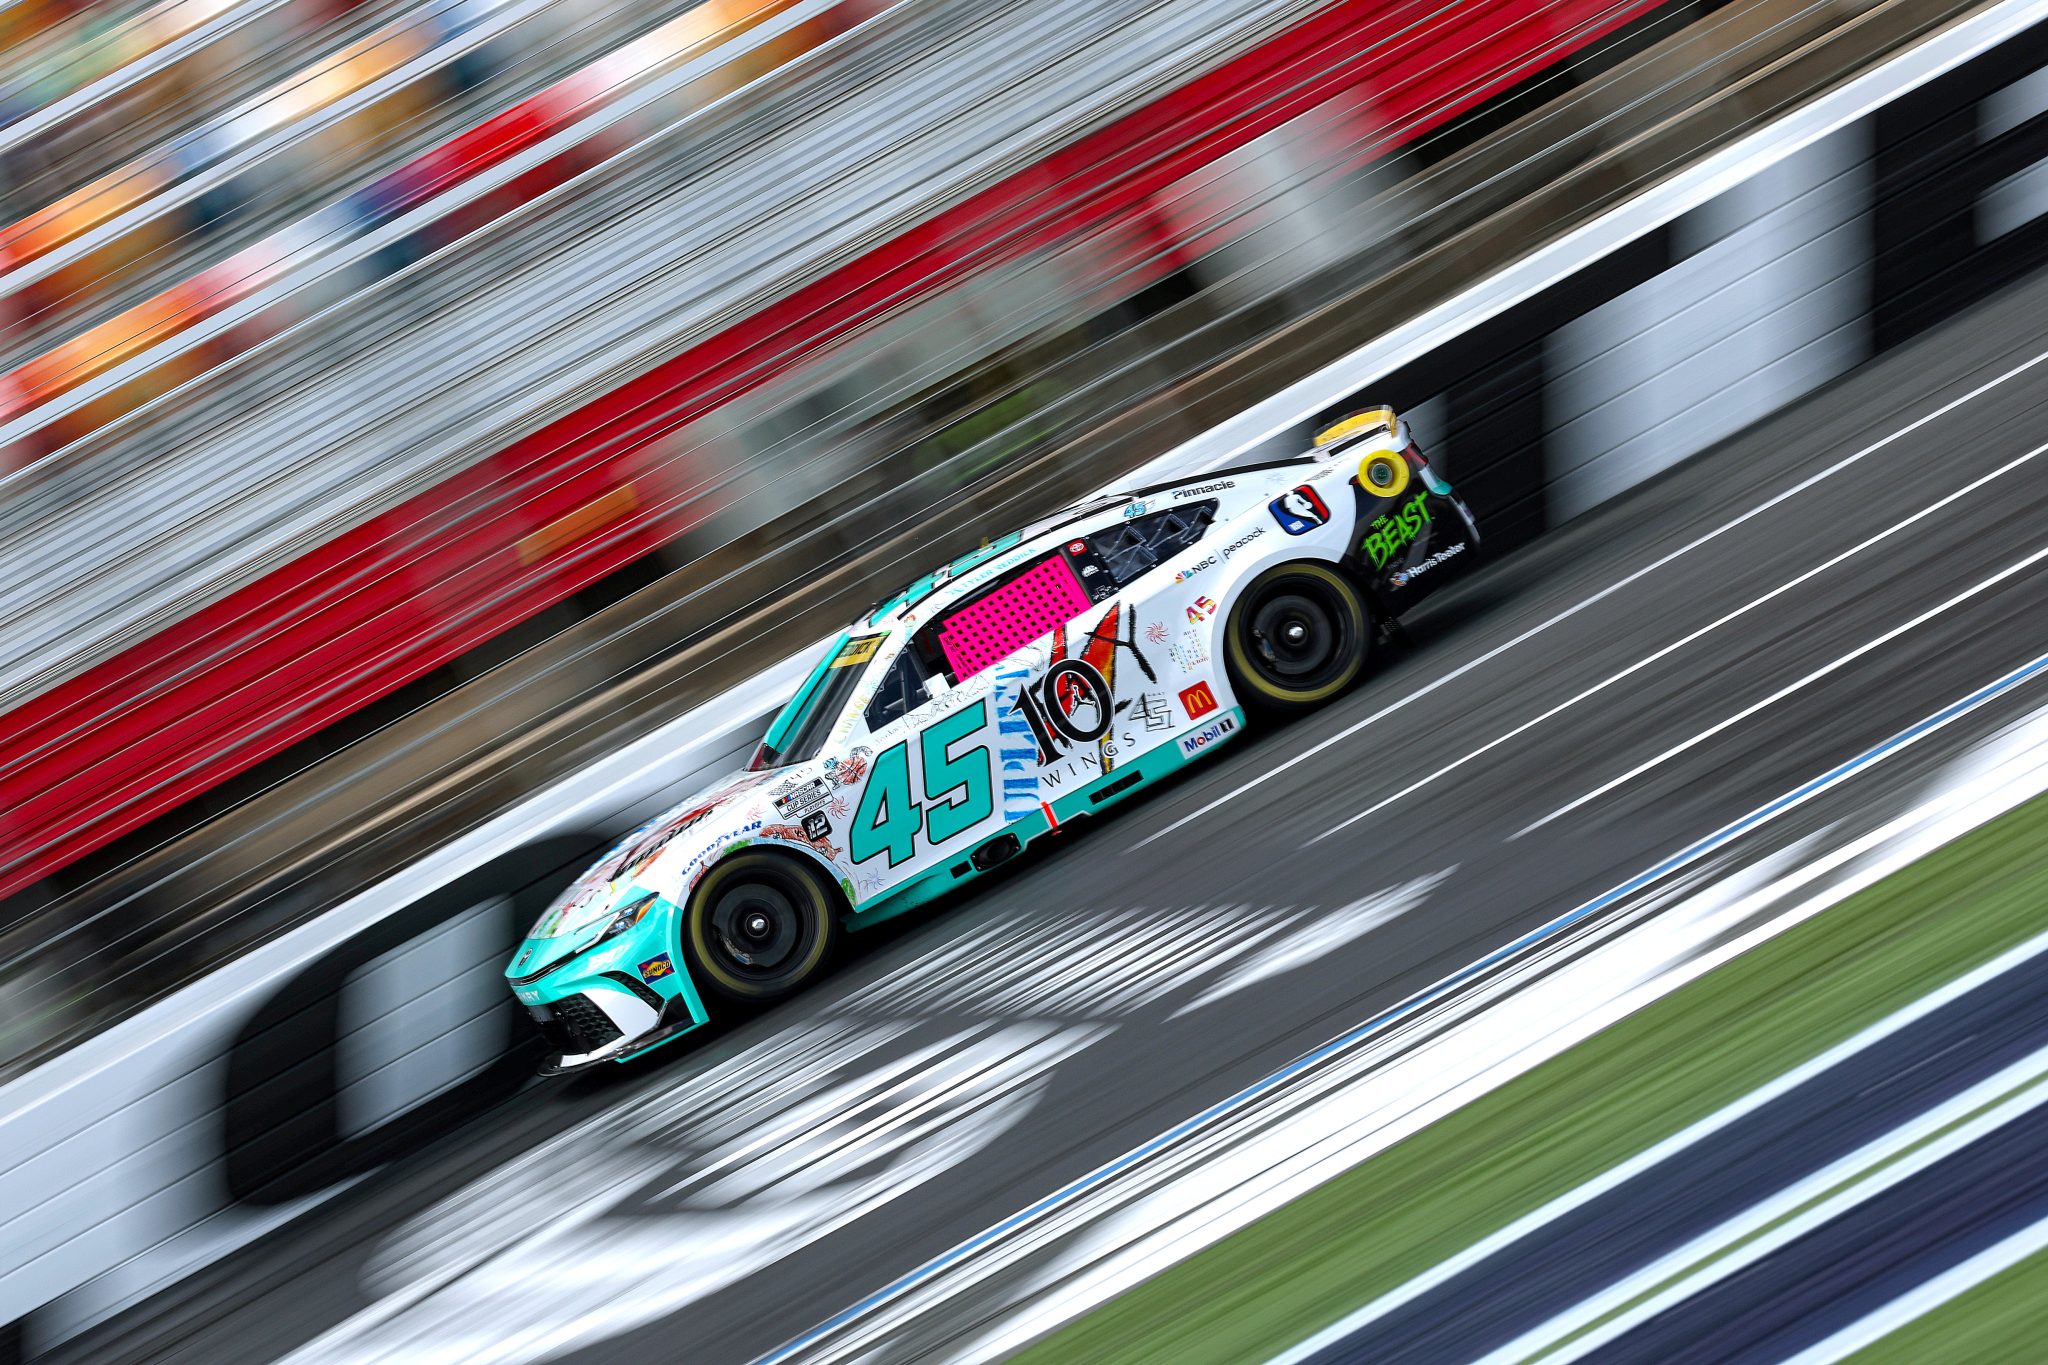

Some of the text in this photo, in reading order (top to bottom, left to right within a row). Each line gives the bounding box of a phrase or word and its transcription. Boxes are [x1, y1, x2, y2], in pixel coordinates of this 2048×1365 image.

[1171, 479, 1236, 499] Pinnacle
[1361, 491, 1432, 571] BEAST
[1370, 514, 1389, 528] THE
[1192, 526, 1266, 575] NBC peacock
[1186, 595, 1218, 625] 45
[1008, 658, 1118, 768] 10
[1184, 719, 1235, 752] Mobil 1
[1042, 732, 1136, 788] WINGS
[789, 781, 816, 800] NASCAR
[850, 697, 994, 870] 45
[786, 789, 822, 812] CUP SERIES
[808, 815, 828, 838] 12
[681, 820, 763, 876] GOODYEAR
[642, 959, 671, 978] SUNOCO
